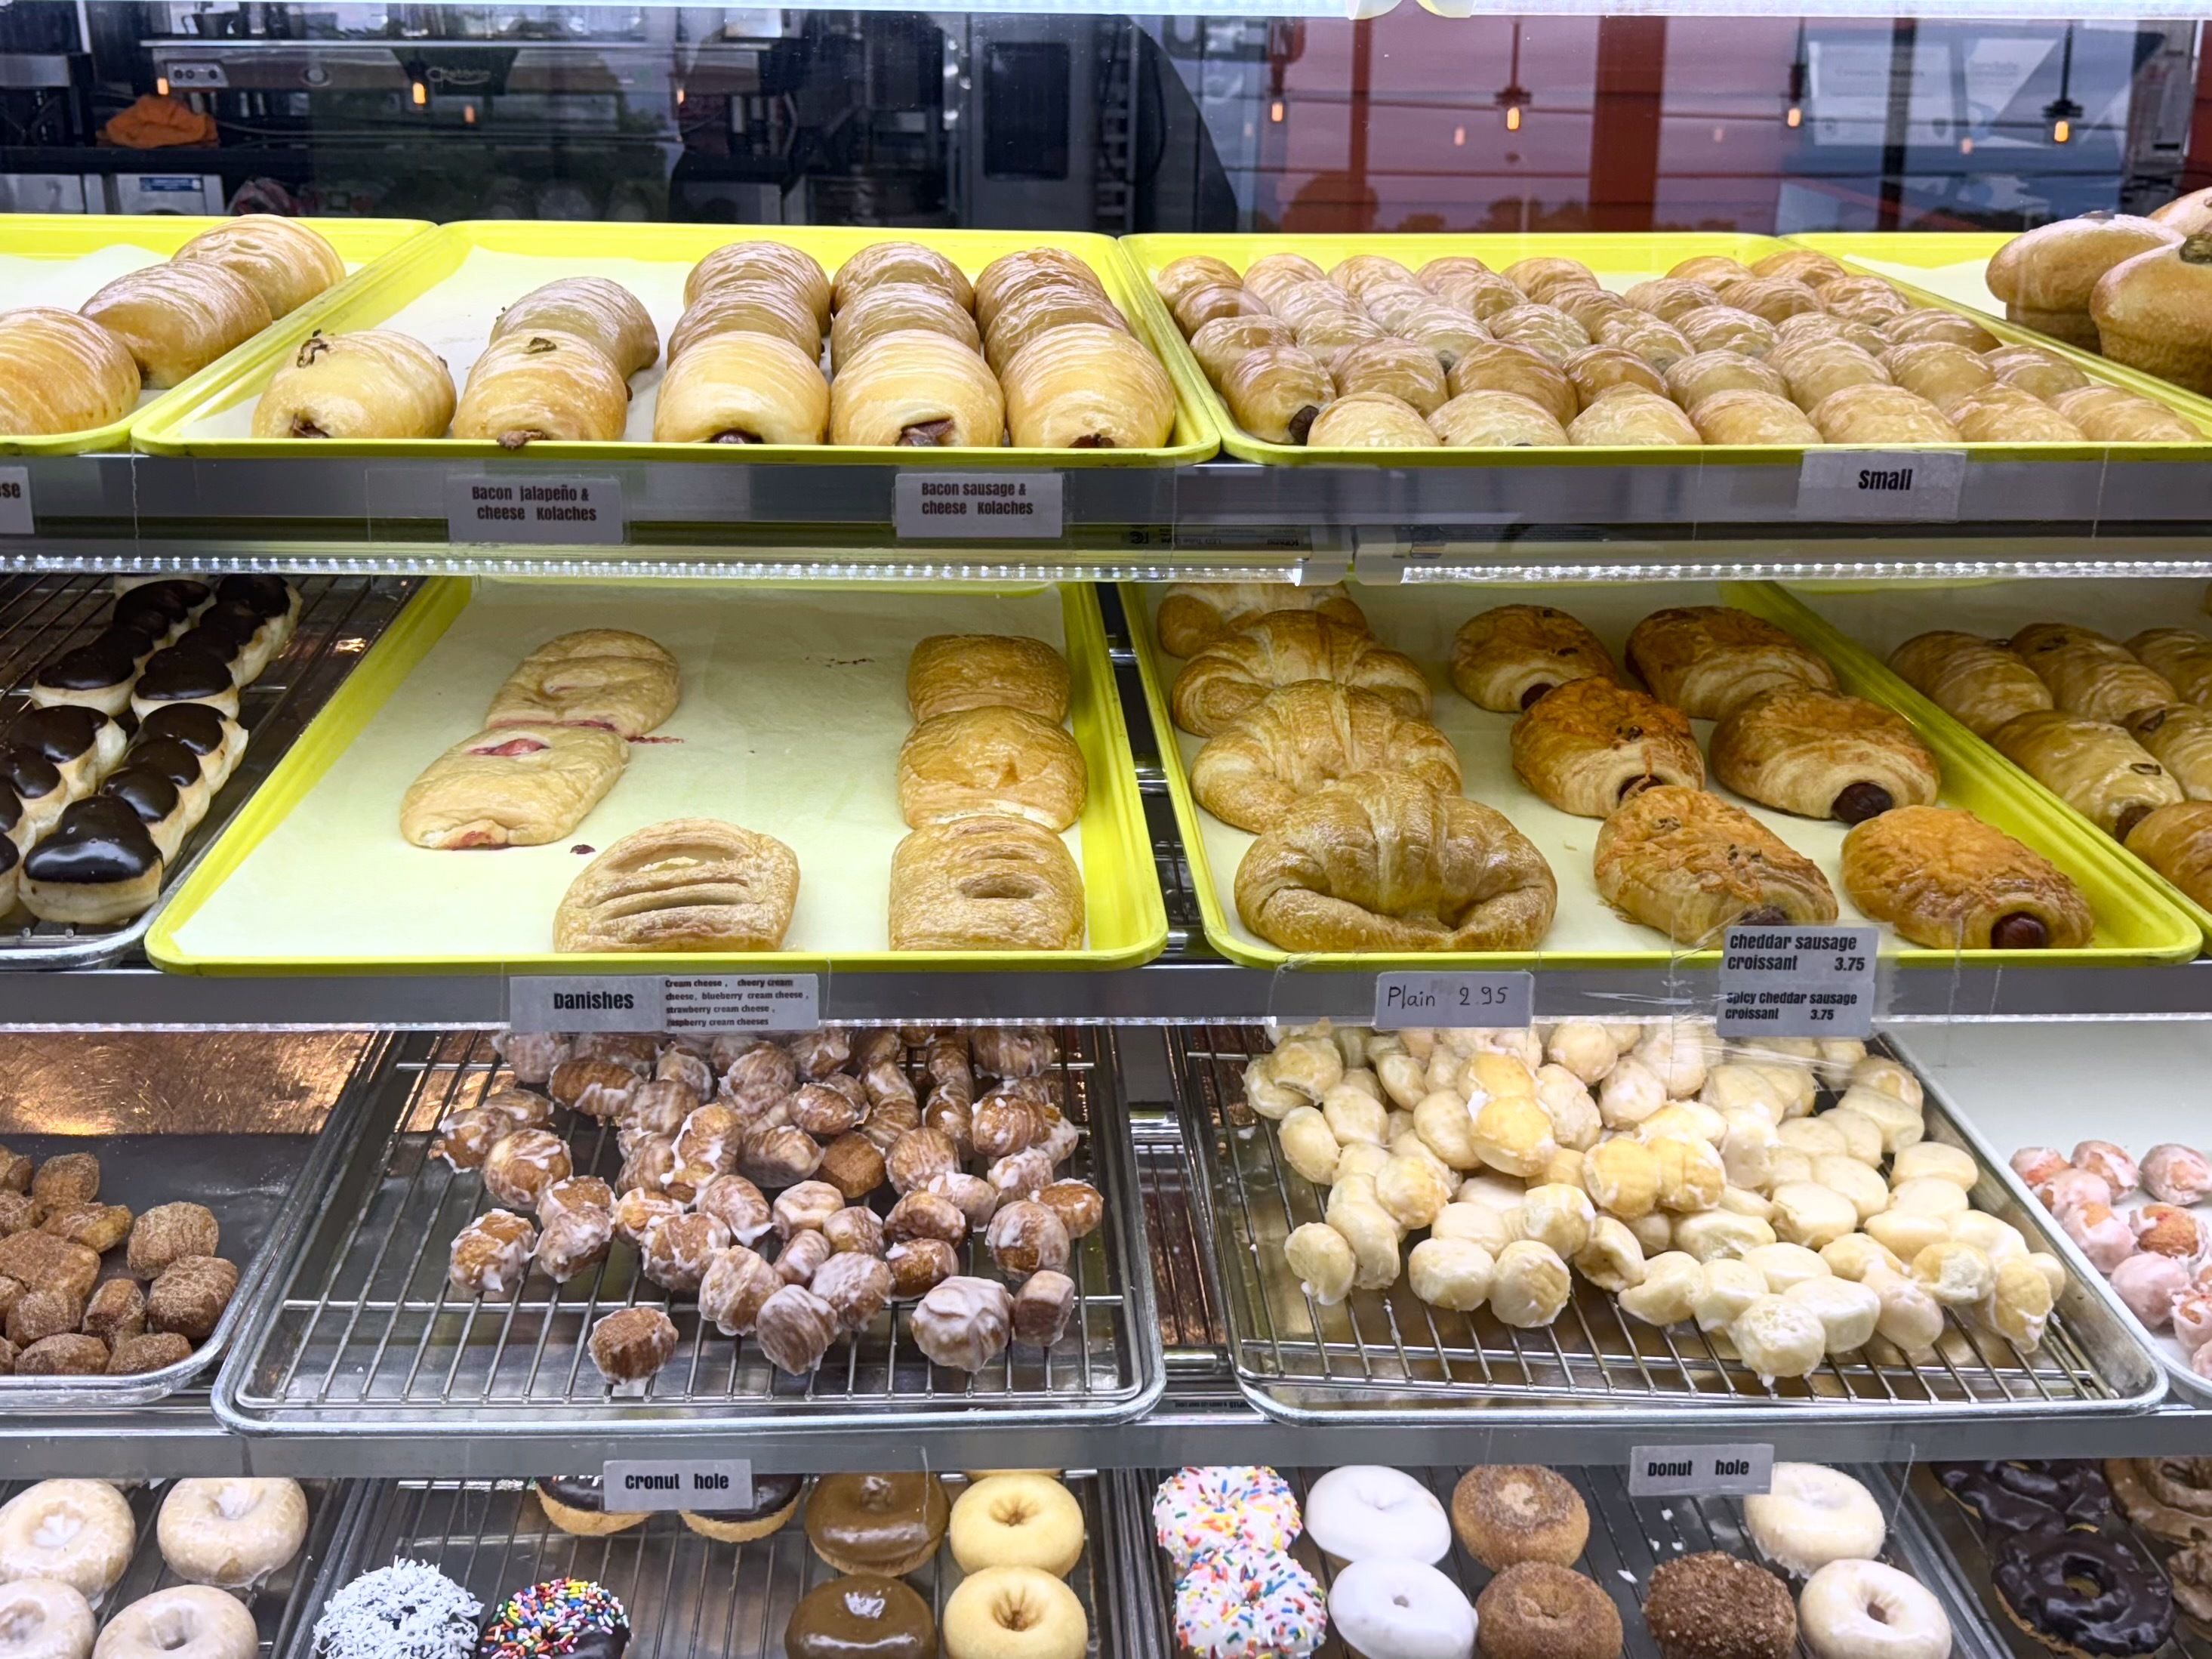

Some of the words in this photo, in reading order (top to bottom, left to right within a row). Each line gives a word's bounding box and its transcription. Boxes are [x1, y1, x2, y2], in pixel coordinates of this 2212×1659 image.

[0, 482, 21, 499] se
[472, 486, 513, 501] Bacon
[580, 488, 590, 501] &
[921, 483, 960, 496] Bacon
[963, 483, 1015, 498] sausage
[1018, 483, 1027, 496] &
[476, 504, 525, 520] cheese
[536, 505, 597, 521] Kolaches
[921, 499, 967, 515] cheese
[977, 499, 1034, 515] Kolaches
[1795, 936, 1857, 952] sausage
[1727, 954, 1798, 971] croissant
[1834, 956, 1865, 972] 3.75
[665, 979, 692, 988] Cream
[553, 991, 635, 1010] Danishes
[701, 991, 743, 1001] blueberry
[1387, 984, 1435, 1010] Plain
[1809, 992, 1858, 1006] sausage
[666, 1005, 711, 1014] strawberry
[1724, 1007, 1779, 1020] croissant
[1810, 1009, 1835, 1020] 3.75
[1647, 1460, 1693, 1477] Donut
[1714, 1458, 1750, 1476] hole
[693, 1472, 729, 1490] hole
